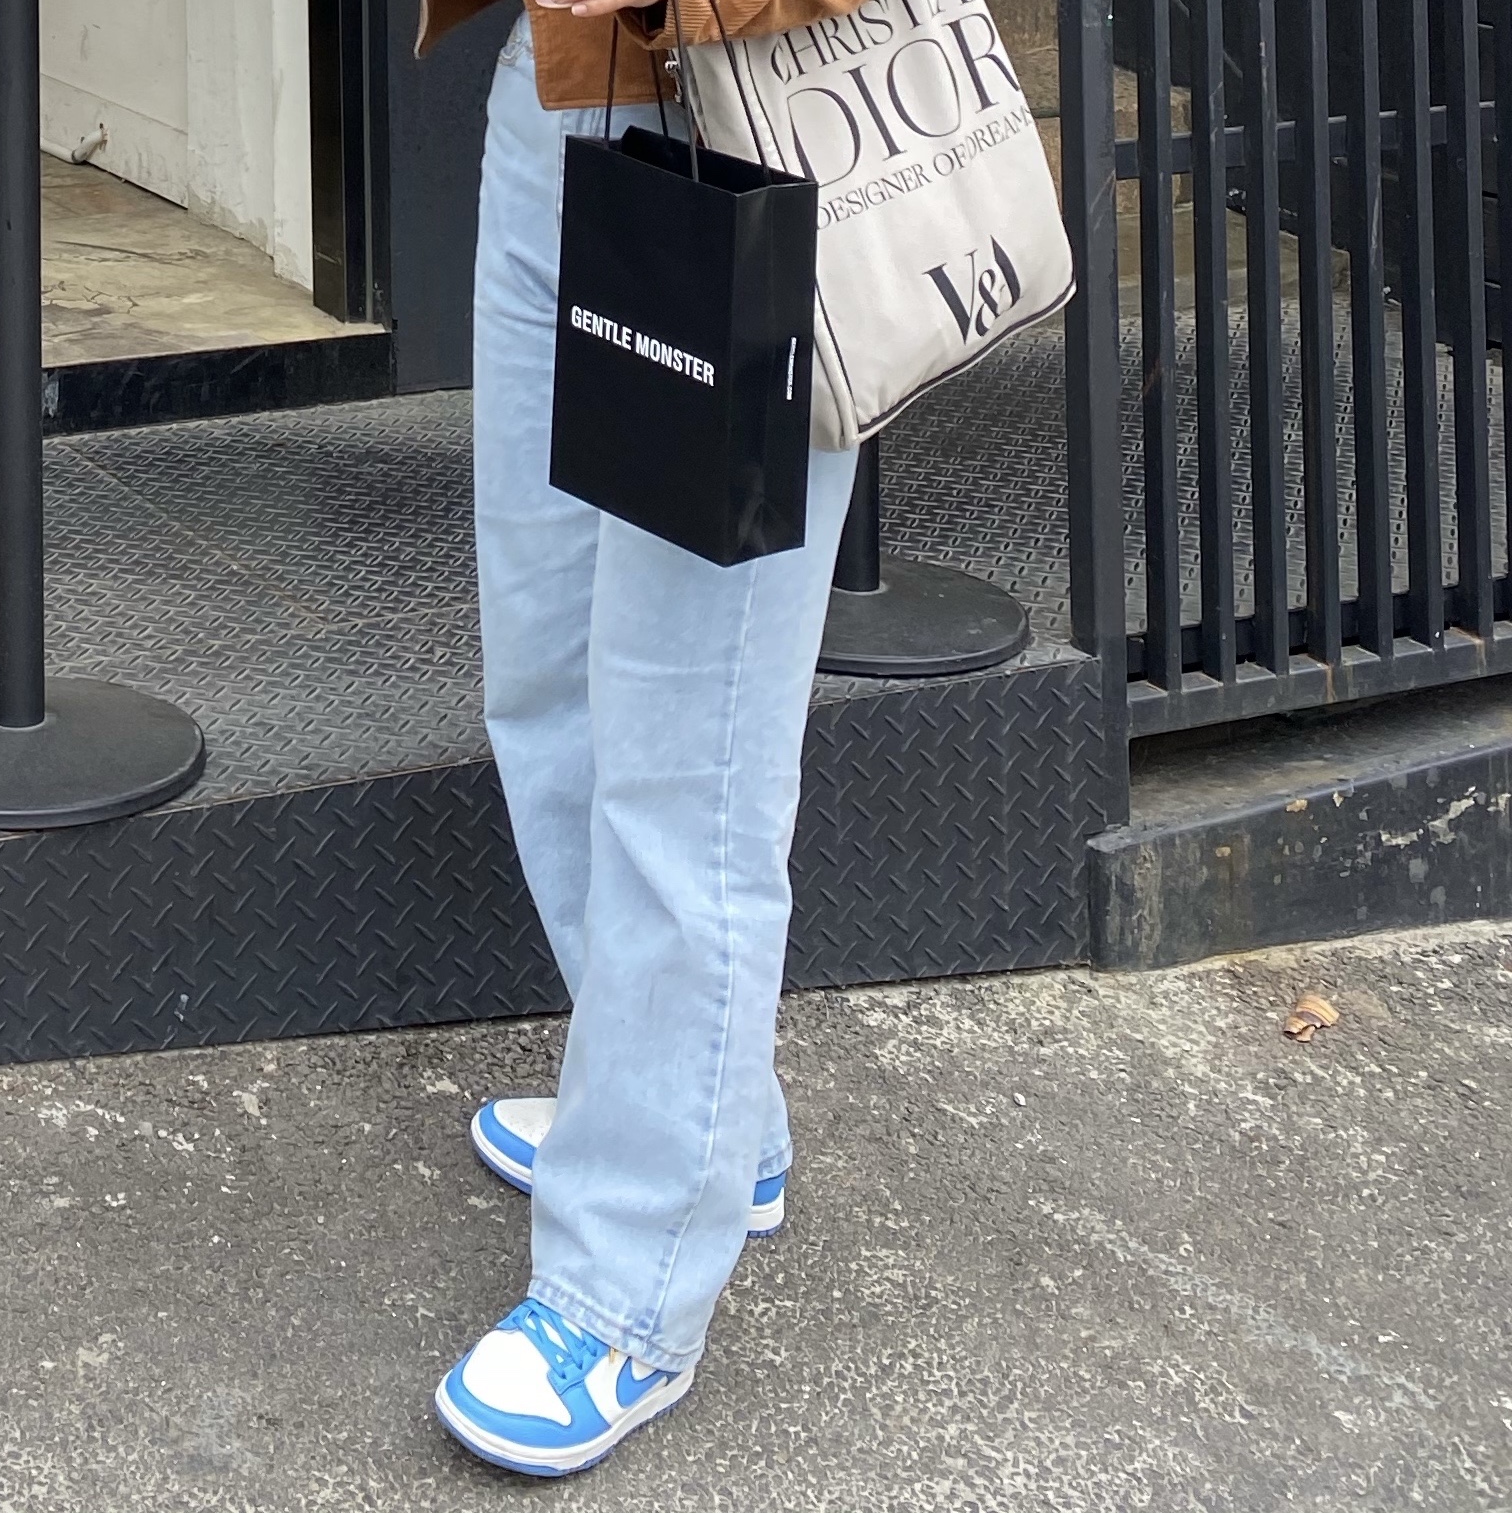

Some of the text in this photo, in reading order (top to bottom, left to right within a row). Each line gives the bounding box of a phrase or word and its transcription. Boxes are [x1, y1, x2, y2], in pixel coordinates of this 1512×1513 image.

[787, 12, 1021, 188] DIOR
[817, 163, 933, 231] DESIGNER
[933, 143, 966, 176] OF
[571, 304, 715, 387] GENTLE MONSTER
